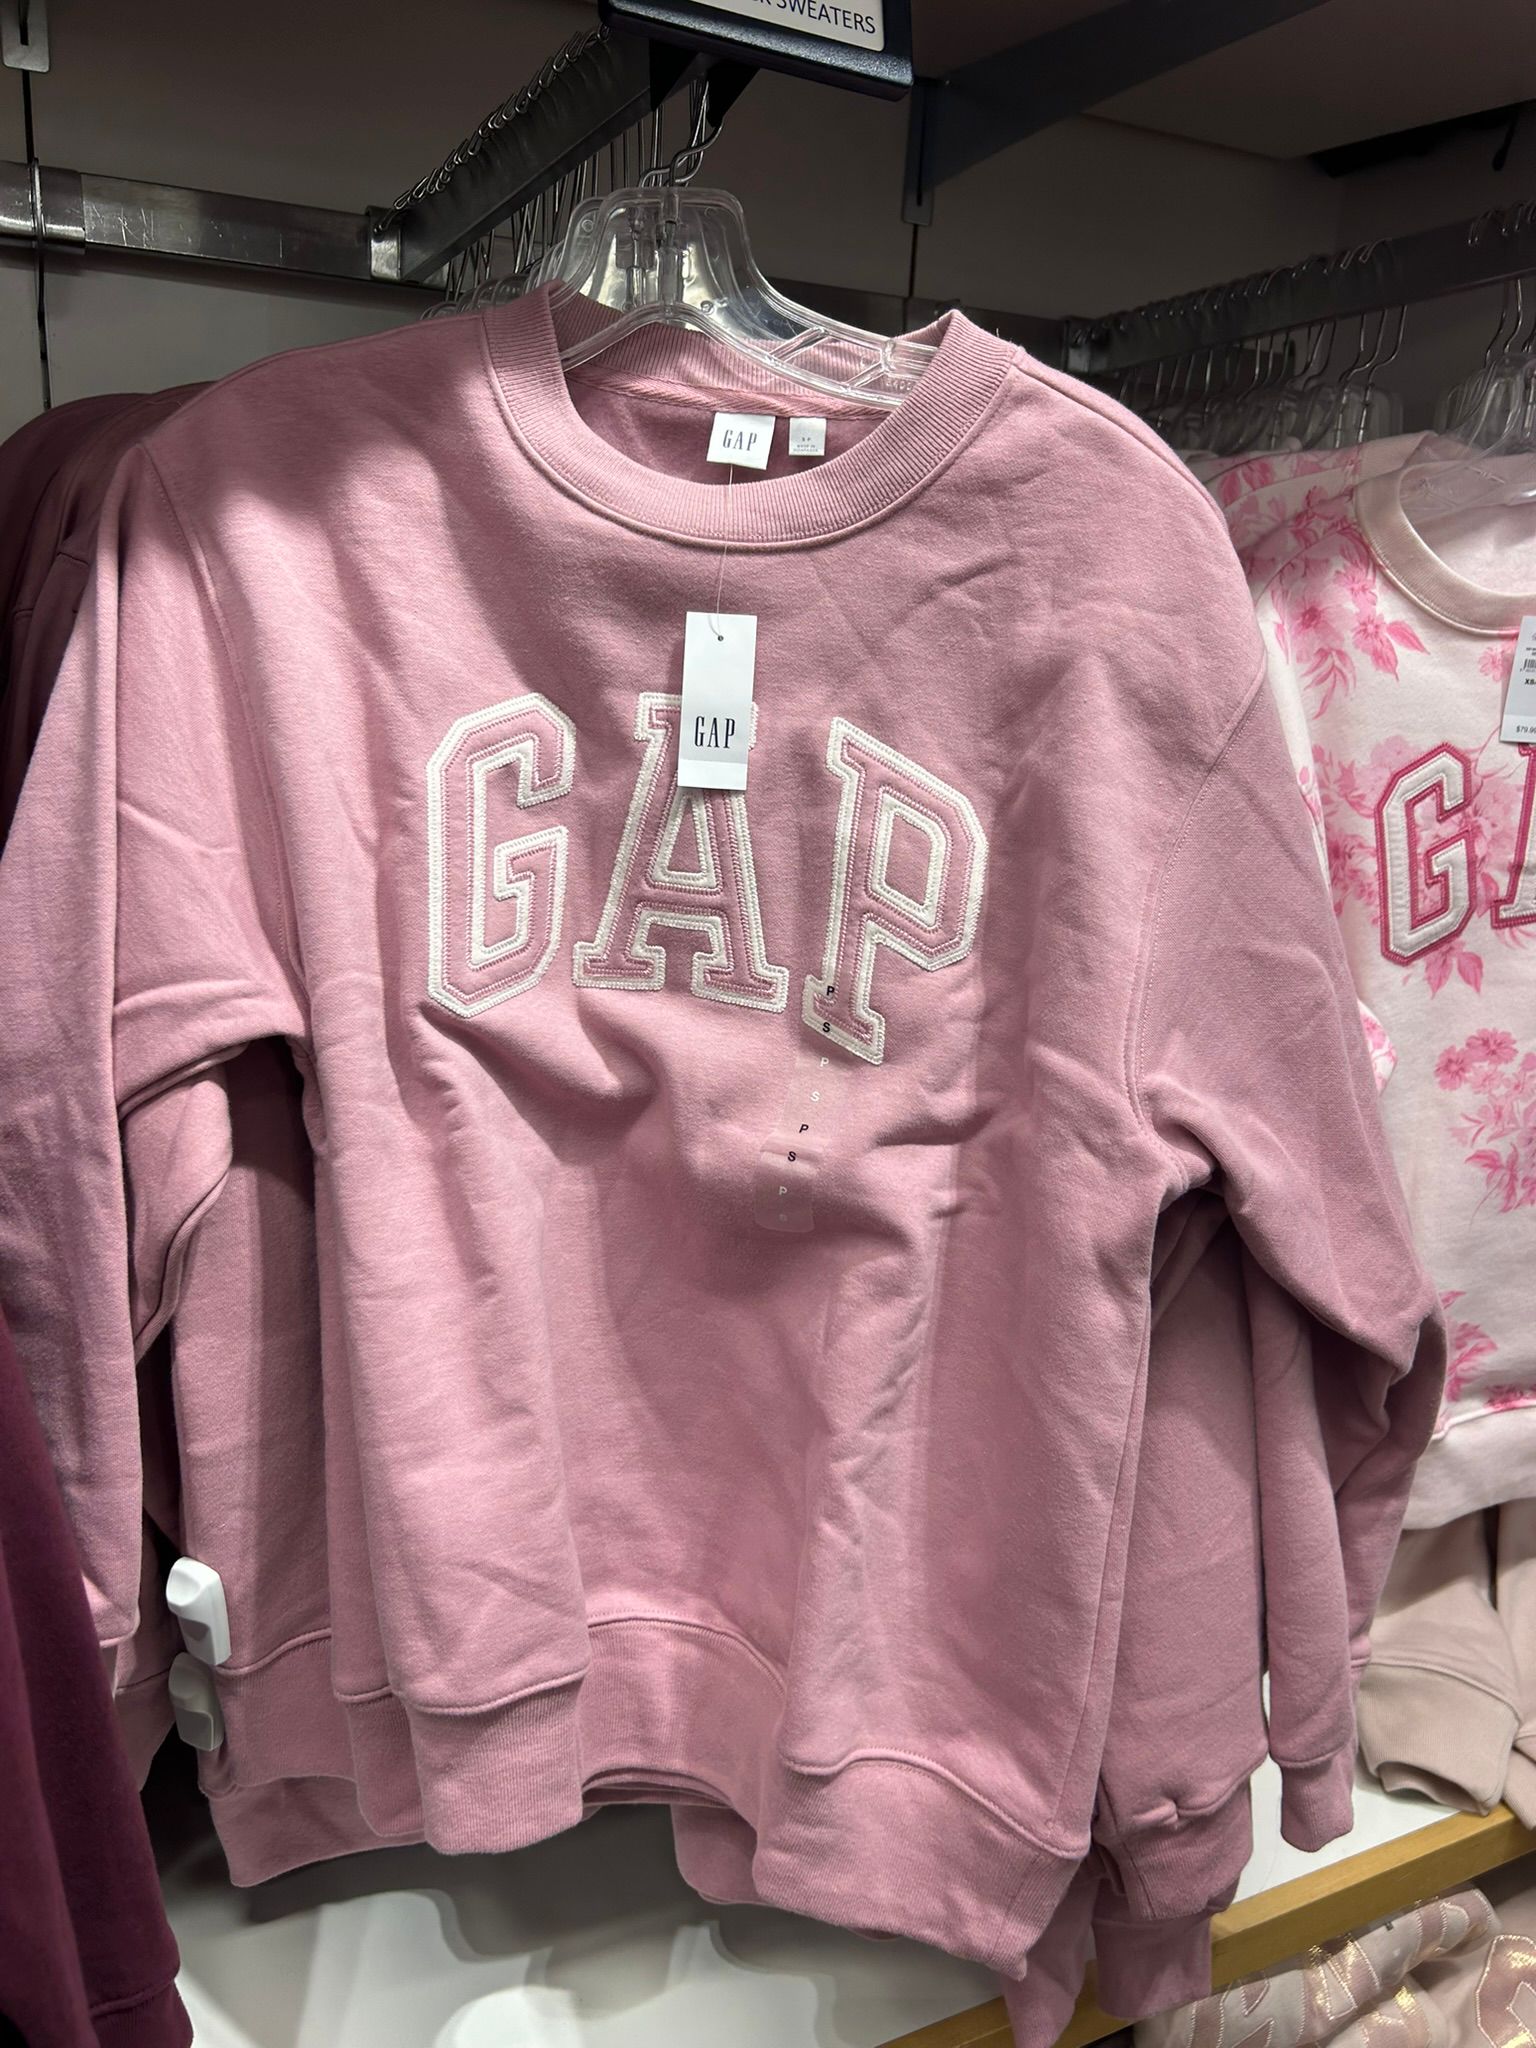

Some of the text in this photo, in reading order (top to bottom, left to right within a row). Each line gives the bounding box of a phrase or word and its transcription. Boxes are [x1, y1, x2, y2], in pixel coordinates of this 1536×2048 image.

[723, 429, 757, 451] GAP
[694, 716, 736, 749] GAP
[426, 692, 989, 1065] GAP
[826, 985, 835, 996] P
[822, 1022, 831, 1033] S
[799, 1124, 809, 1134] P
[787, 1151, 797, 1162] S
